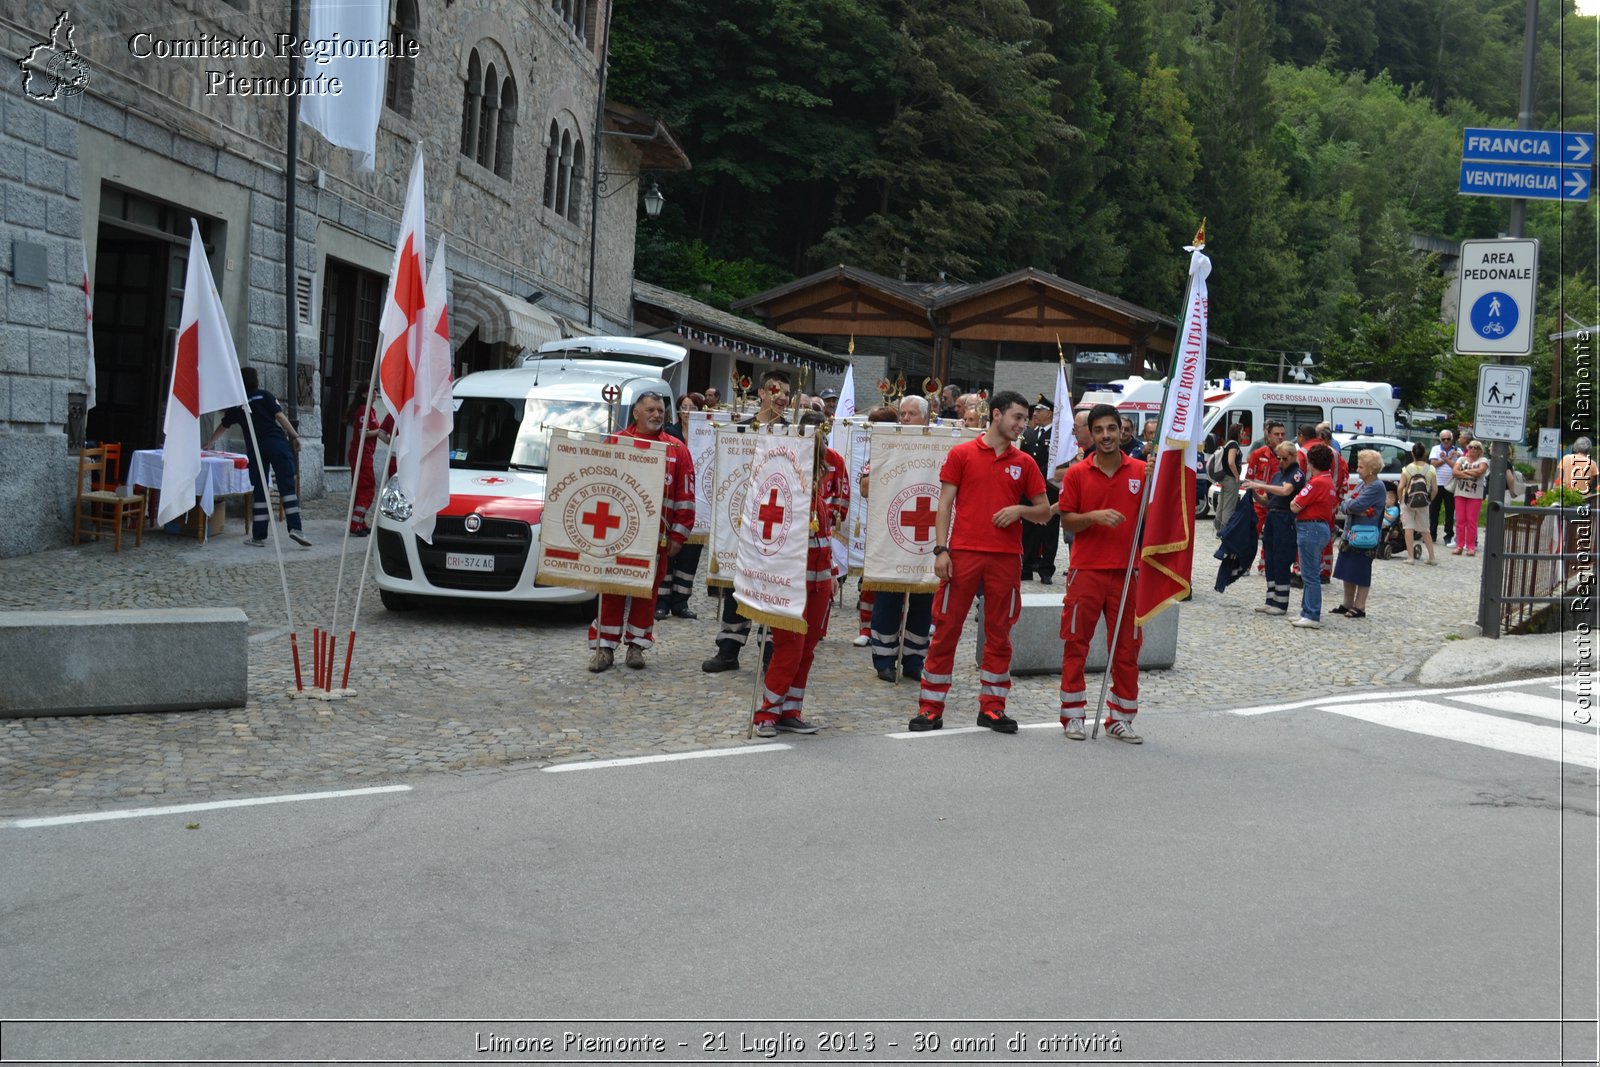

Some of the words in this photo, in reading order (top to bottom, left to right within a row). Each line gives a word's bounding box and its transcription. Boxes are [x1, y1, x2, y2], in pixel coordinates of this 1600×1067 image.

[1468, 137, 1551, 155] FRANCIA
[1466, 170, 1558, 190] VENTIMIGLIA
[1482, 253, 1515, 264] AREA
[1464, 268, 1531, 280] PEDONALE
[1179, 349, 1200, 391] ROSSA
[1262, 393, 1284, 401] CROCE
[1285, 394, 1307, 402] ROSSA
[1308, 395, 1335, 404] ITALIANA
[1336, 397, 1358, 405] LIMONE
[1171, 393, 1192, 433] CROCE
[557, 444, 577, 455] CORPO
[579, 447, 611, 460] VOLONTARI
[615, 452, 626, 460] DEL
[628, 454, 659, 464] SOCCORSO
[880, 464, 908, 485] CROCE
[908, 459, 936, 470] ROSSA
[549, 472, 579, 503] CROCE
[580, 465, 618, 478] ROSSA
[620, 472, 657, 518] ITALIANA
[580, 489, 589, 498] DI
[717, 468, 741, 501] CROCE
[592, 485, 627, 503] GINEVRA
[626, 503, 636, 513] 22
[889, 496, 904, 544] CONVENZIONE
[902, 490, 911, 499] DI
[911, 485, 940, 497] GINEVRA
[566, 497, 592, 551] CONVENZIONE
[622, 515, 638, 544] AGOSTO
[464, 557, 480, 568] 374
[482, 558, 493, 568] AC
[544, 559, 591, 573] COMITATO
[594, 564, 602, 574] DI
[767, 573, 791, 587] LOCALE
[760, 593, 790, 607] PIEMONTE
